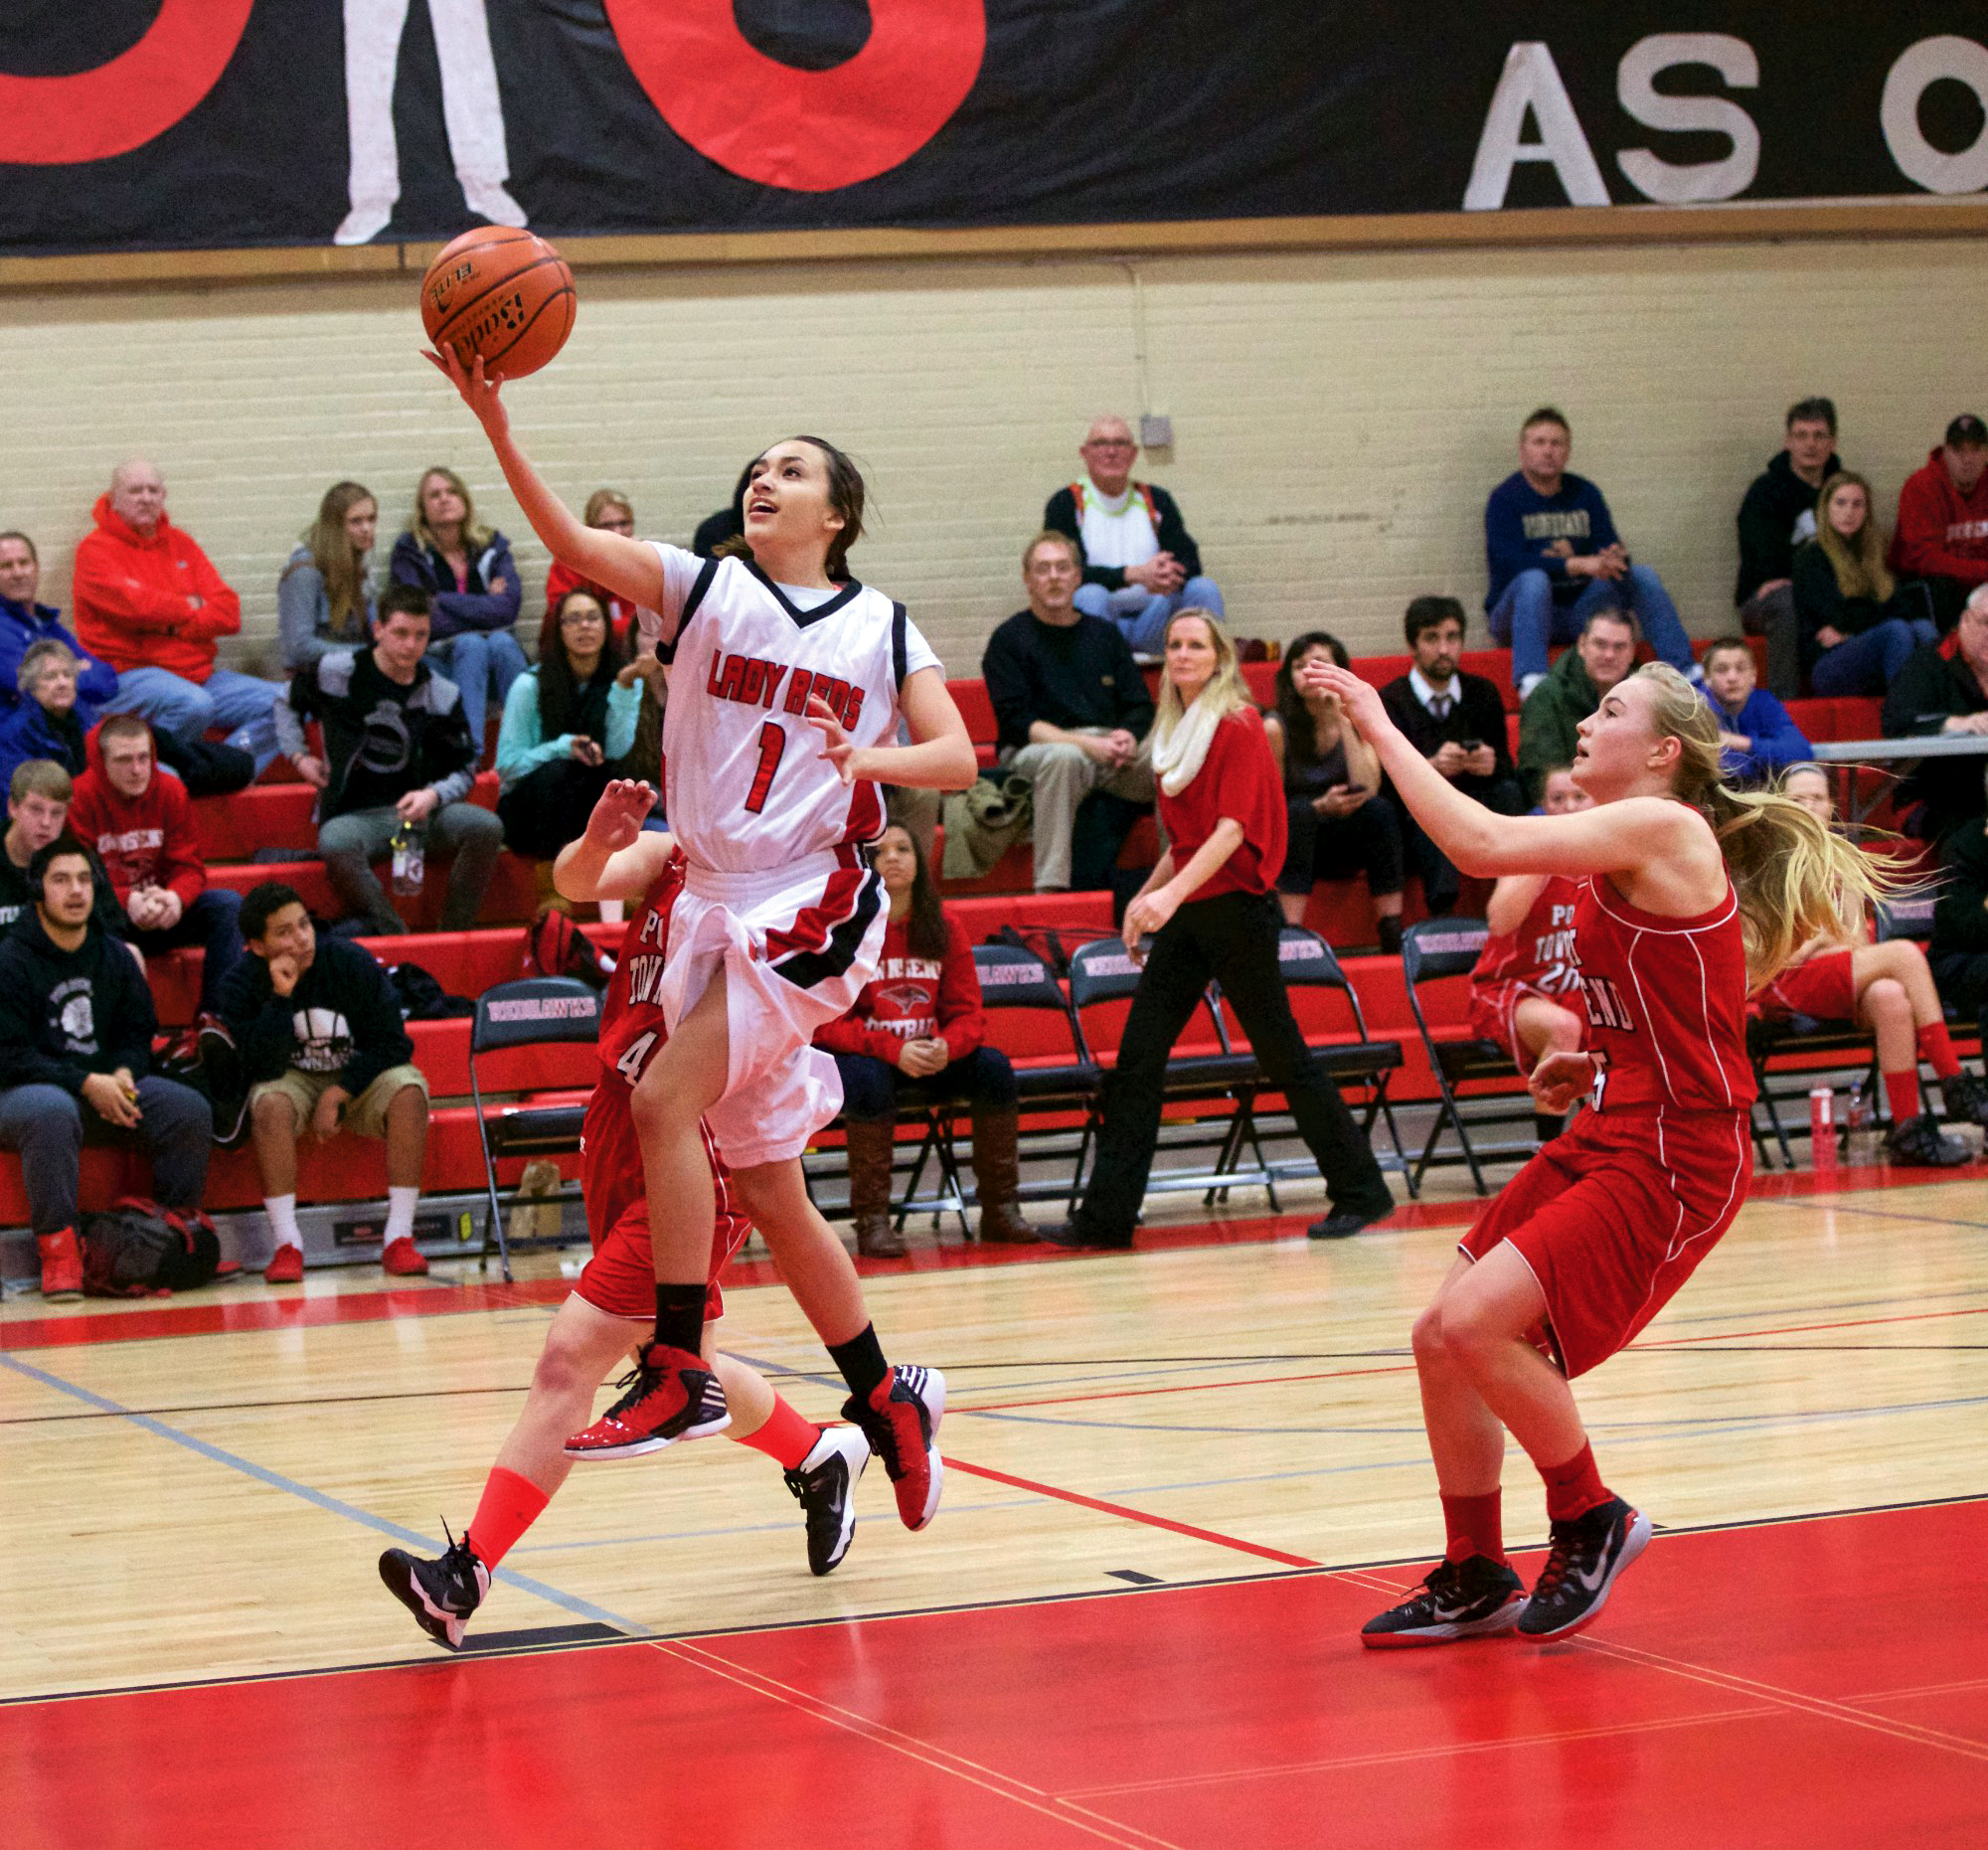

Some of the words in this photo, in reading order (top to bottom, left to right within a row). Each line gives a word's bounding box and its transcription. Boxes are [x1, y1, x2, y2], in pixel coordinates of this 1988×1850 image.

[1462, 32, 1760, 211] AS
[707, 649, 789, 710] LADY
[782, 667, 866, 733] REDS
[745, 721, 786, 814] 1
[616, 1030, 658, 1088] 4
